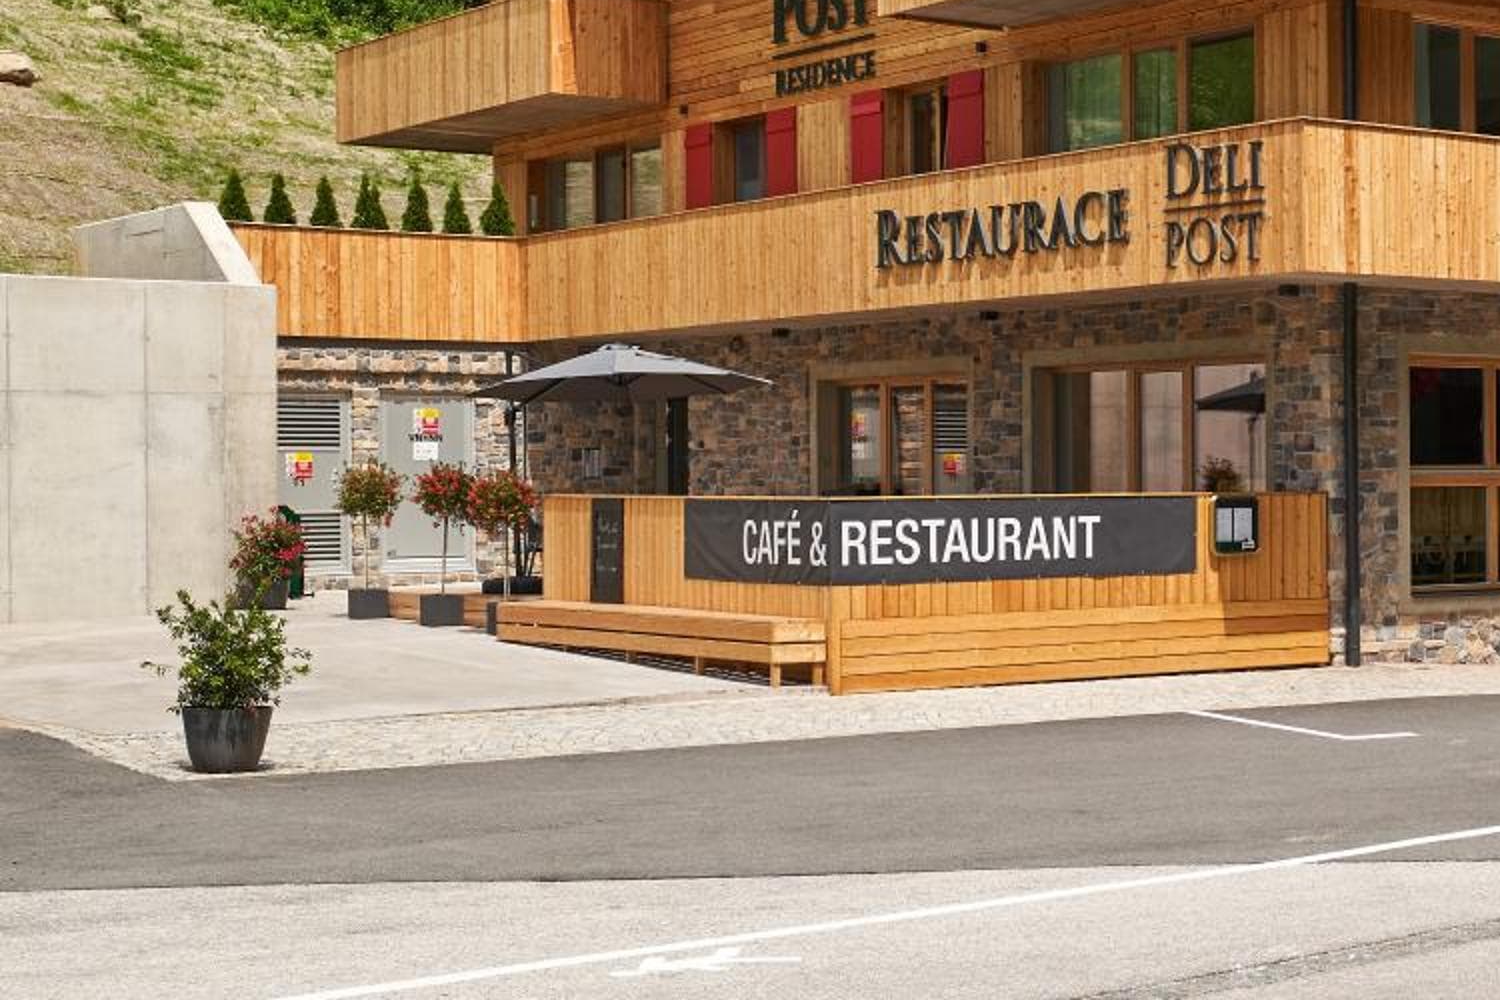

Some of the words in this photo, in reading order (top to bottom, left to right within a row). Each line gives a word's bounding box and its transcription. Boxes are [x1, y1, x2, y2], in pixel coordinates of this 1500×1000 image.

[773, 50, 876, 97] RESIDENCE
[1164, 140, 1264, 200] DELI
[874, 188, 1131, 269] RESTAURACE
[1165, 211, 1263, 268] POST
[743, 509, 802, 566] CAFÉ
[809, 520, 828, 567] &
[841, 514, 1101, 566] RESTAURANT
